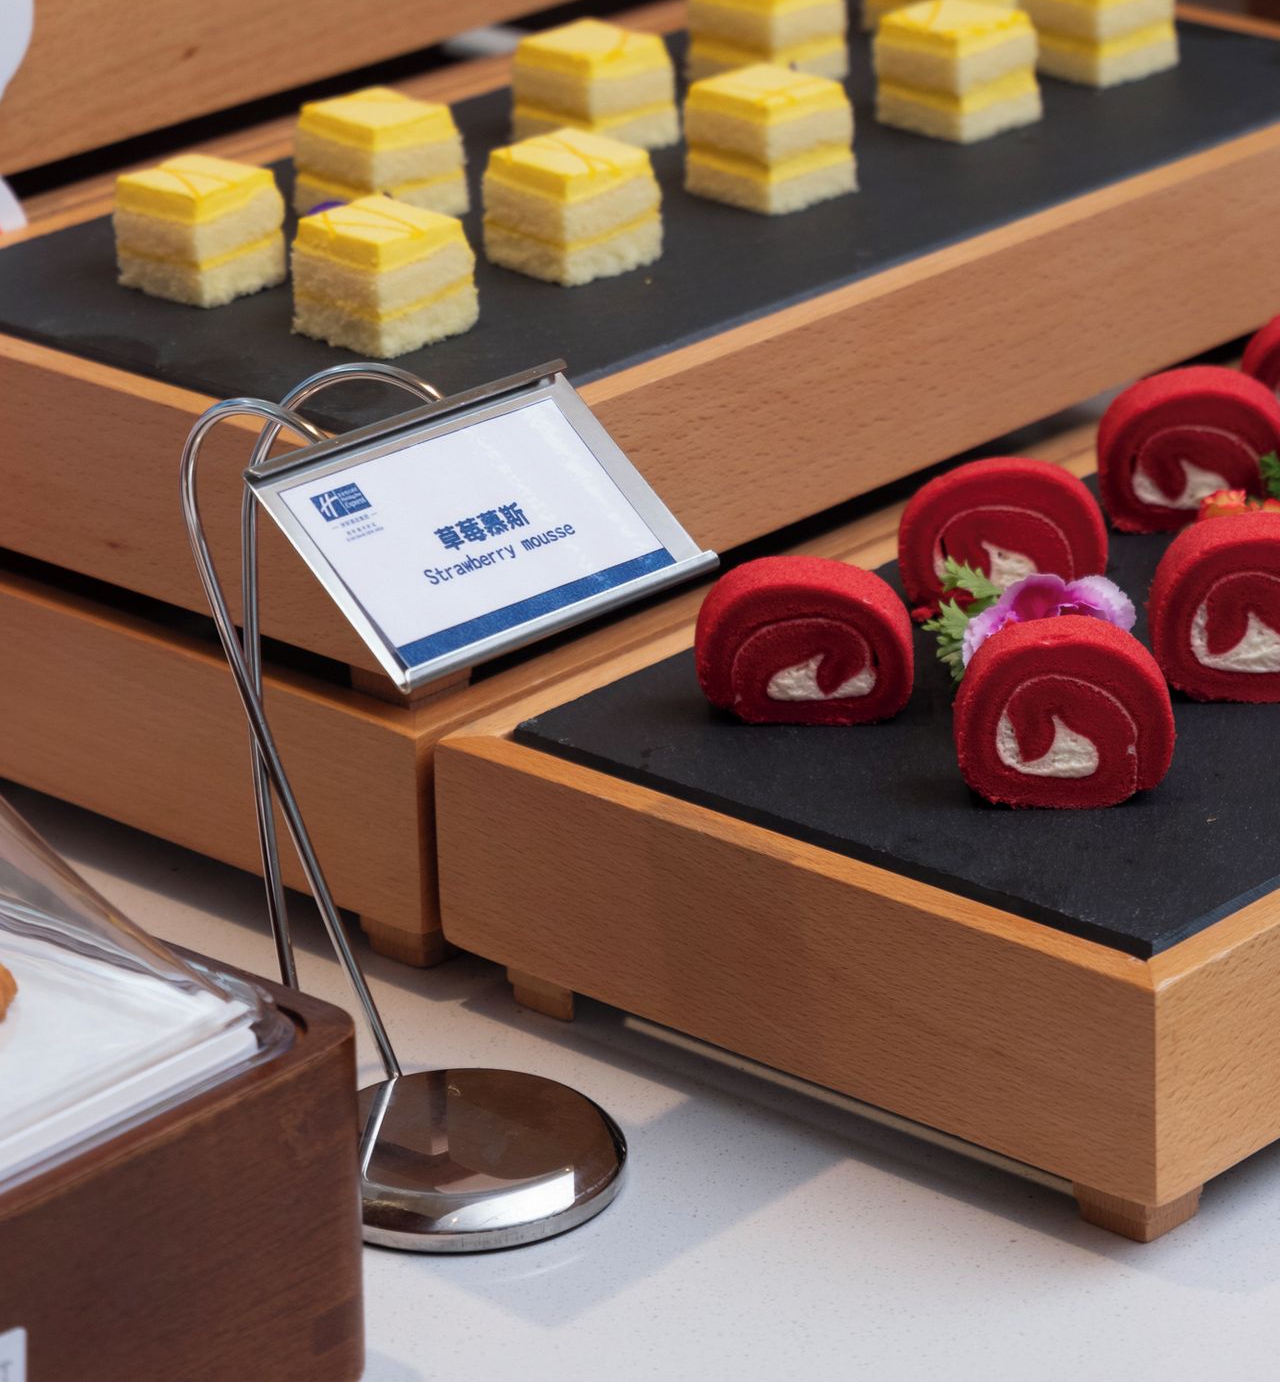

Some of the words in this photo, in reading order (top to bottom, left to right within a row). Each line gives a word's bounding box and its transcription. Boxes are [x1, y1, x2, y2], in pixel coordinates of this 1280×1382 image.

[423, 544, 517, 585] Strawberry
[520, 523, 576, 551] mousse
[433, 501, 530, 551] 草莓慕斯
